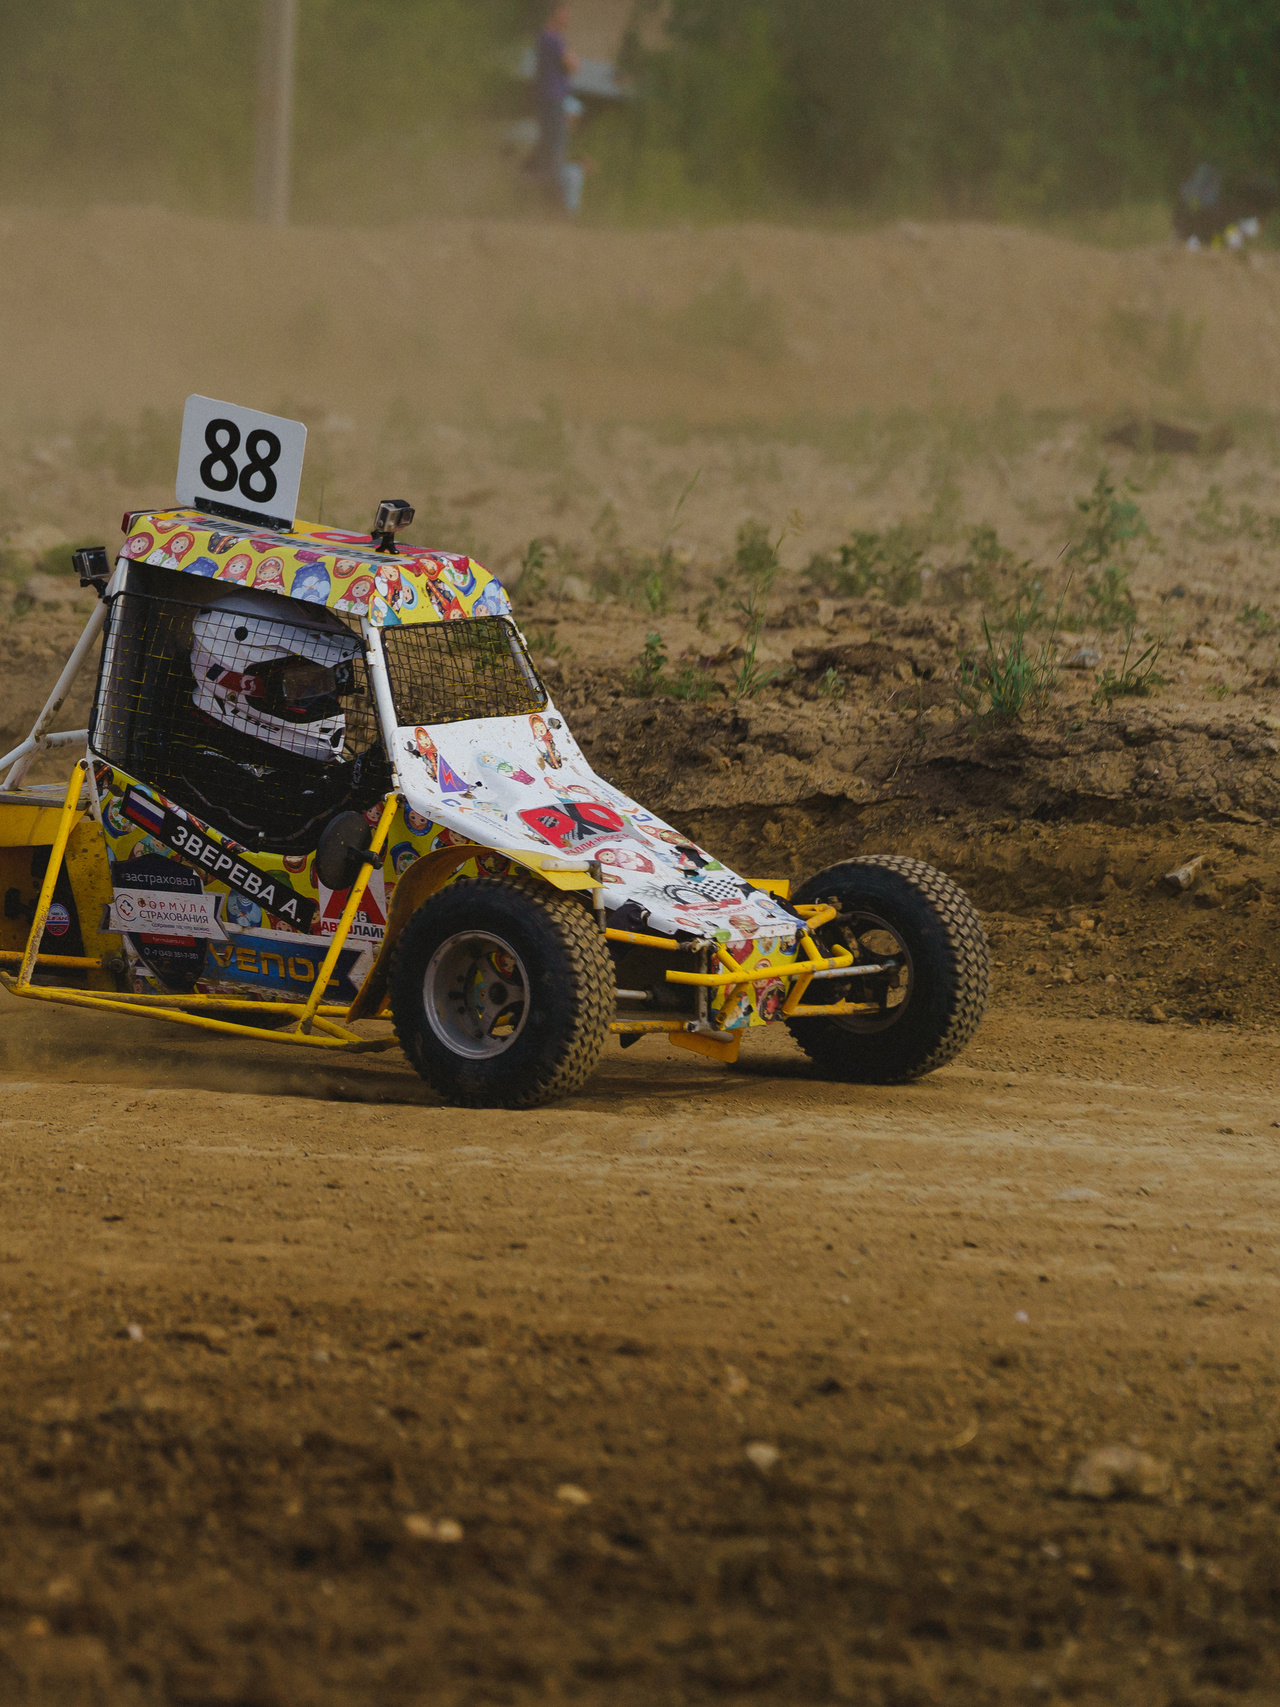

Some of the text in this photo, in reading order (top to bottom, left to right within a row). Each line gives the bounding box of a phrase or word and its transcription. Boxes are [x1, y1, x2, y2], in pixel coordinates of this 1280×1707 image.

[200, 418, 281, 503] 88
[171, 826, 301, 923] ЗВЕРЕВА А.
[138, 900, 207, 913] ФОРМУЛА
[140, 910, 209, 924] СТРАХОВАНИЯ
[321, 921, 385, 938] АВОЛАЙ
